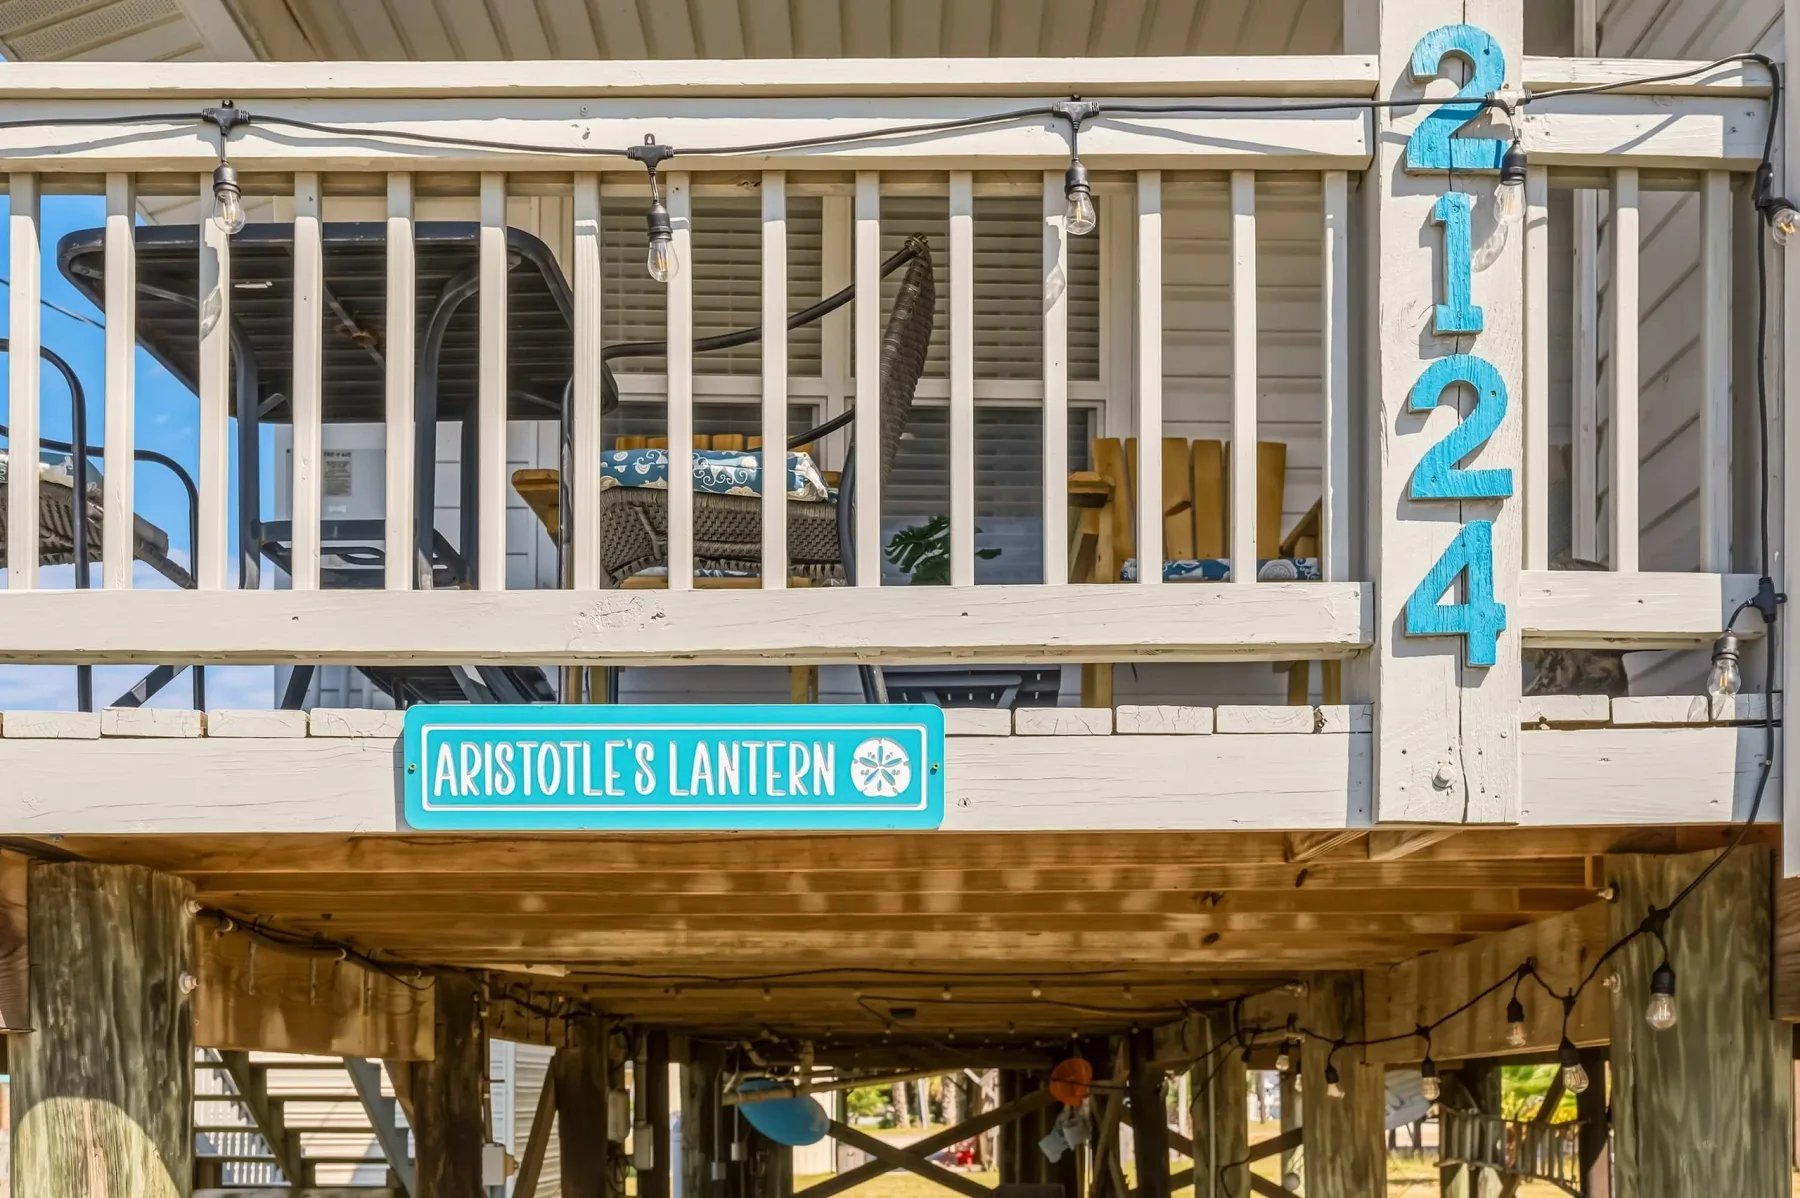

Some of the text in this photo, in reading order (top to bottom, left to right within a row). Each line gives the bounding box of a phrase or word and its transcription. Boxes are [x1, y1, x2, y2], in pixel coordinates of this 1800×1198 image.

[1405, 24, 1513, 667] 2124
[434, 739, 835, 797] ARISTOTLE'S LANTERN
